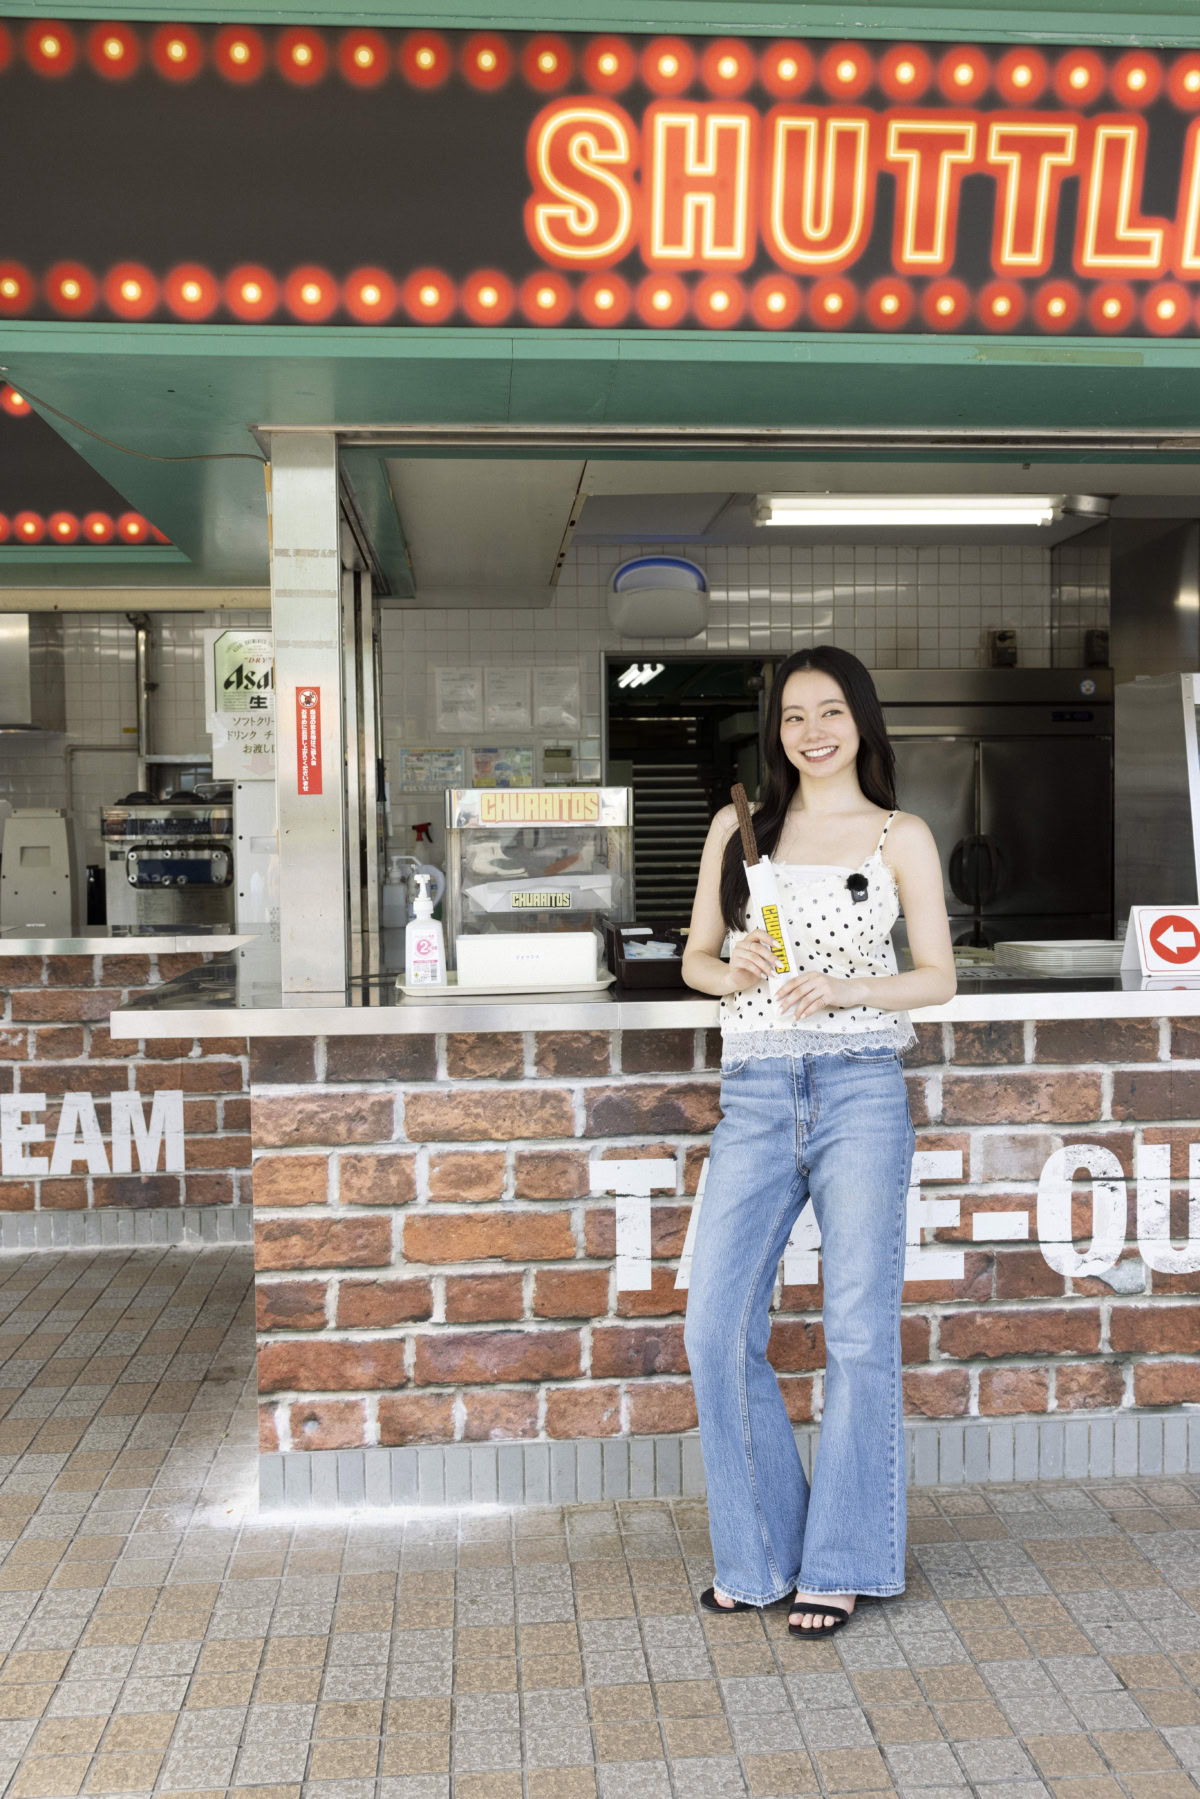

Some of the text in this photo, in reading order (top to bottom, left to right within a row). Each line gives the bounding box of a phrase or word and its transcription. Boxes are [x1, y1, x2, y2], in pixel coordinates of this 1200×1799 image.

[249, 695, 268, 709] 生
[232, 717, 275, 728] ソフトクリ
[227, 731, 258, 741] ドリンク
[480, 792, 600, 824] CHURRITOS
[511, 893, 570, 908] CHURRITOS
